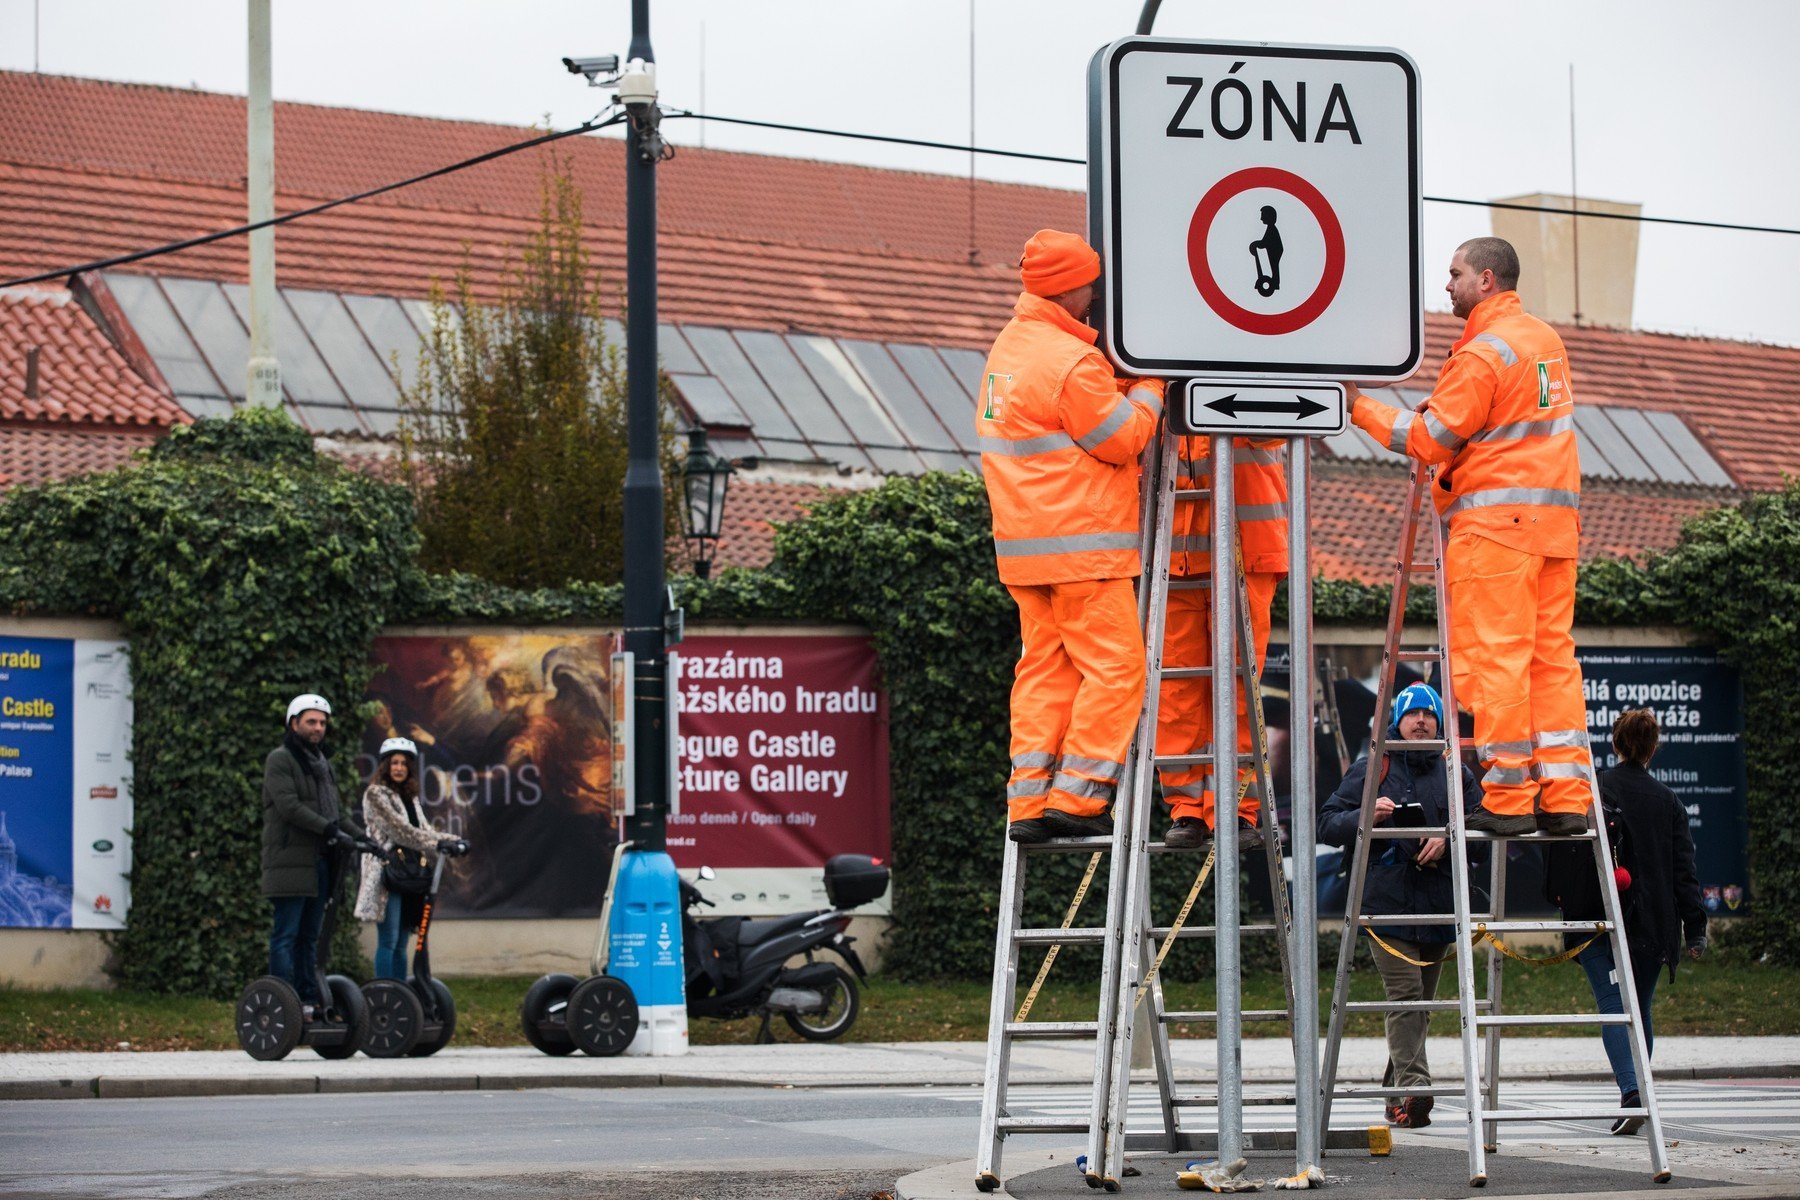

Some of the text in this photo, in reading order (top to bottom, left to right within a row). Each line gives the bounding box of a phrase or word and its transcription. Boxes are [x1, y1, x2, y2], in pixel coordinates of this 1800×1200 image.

[1166, 61, 1362, 145] ZÓNA
[0, 649, 41, 669] radu
[676, 650, 783, 679] razárna
[676, 684, 877, 713] ažského hradu
[1583, 679, 1701, 705] álá expozice
[2, 696, 55, 718] Castle
[676, 729, 836, 763] ague Castle
[0, 764, 33, 778] Palace
[677, 764, 848, 797] ture Gallery
[1649, 769, 1698, 782] hibition
[700, 811, 738, 825] denně
[742, 812, 748, 824] /
[751, 811, 782, 826] Open
[786, 812, 816, 826] daily
[1205, 848, 1215, 866] FOR
[1072, 883, 1087, 907] FORTE
[1176, 901, 1192, 925] FORTE
[660, 922, 668, 933] 2
[1046, 944, 1059, 964] FORT
[1019, 996, 1034, 1020] FORTE
